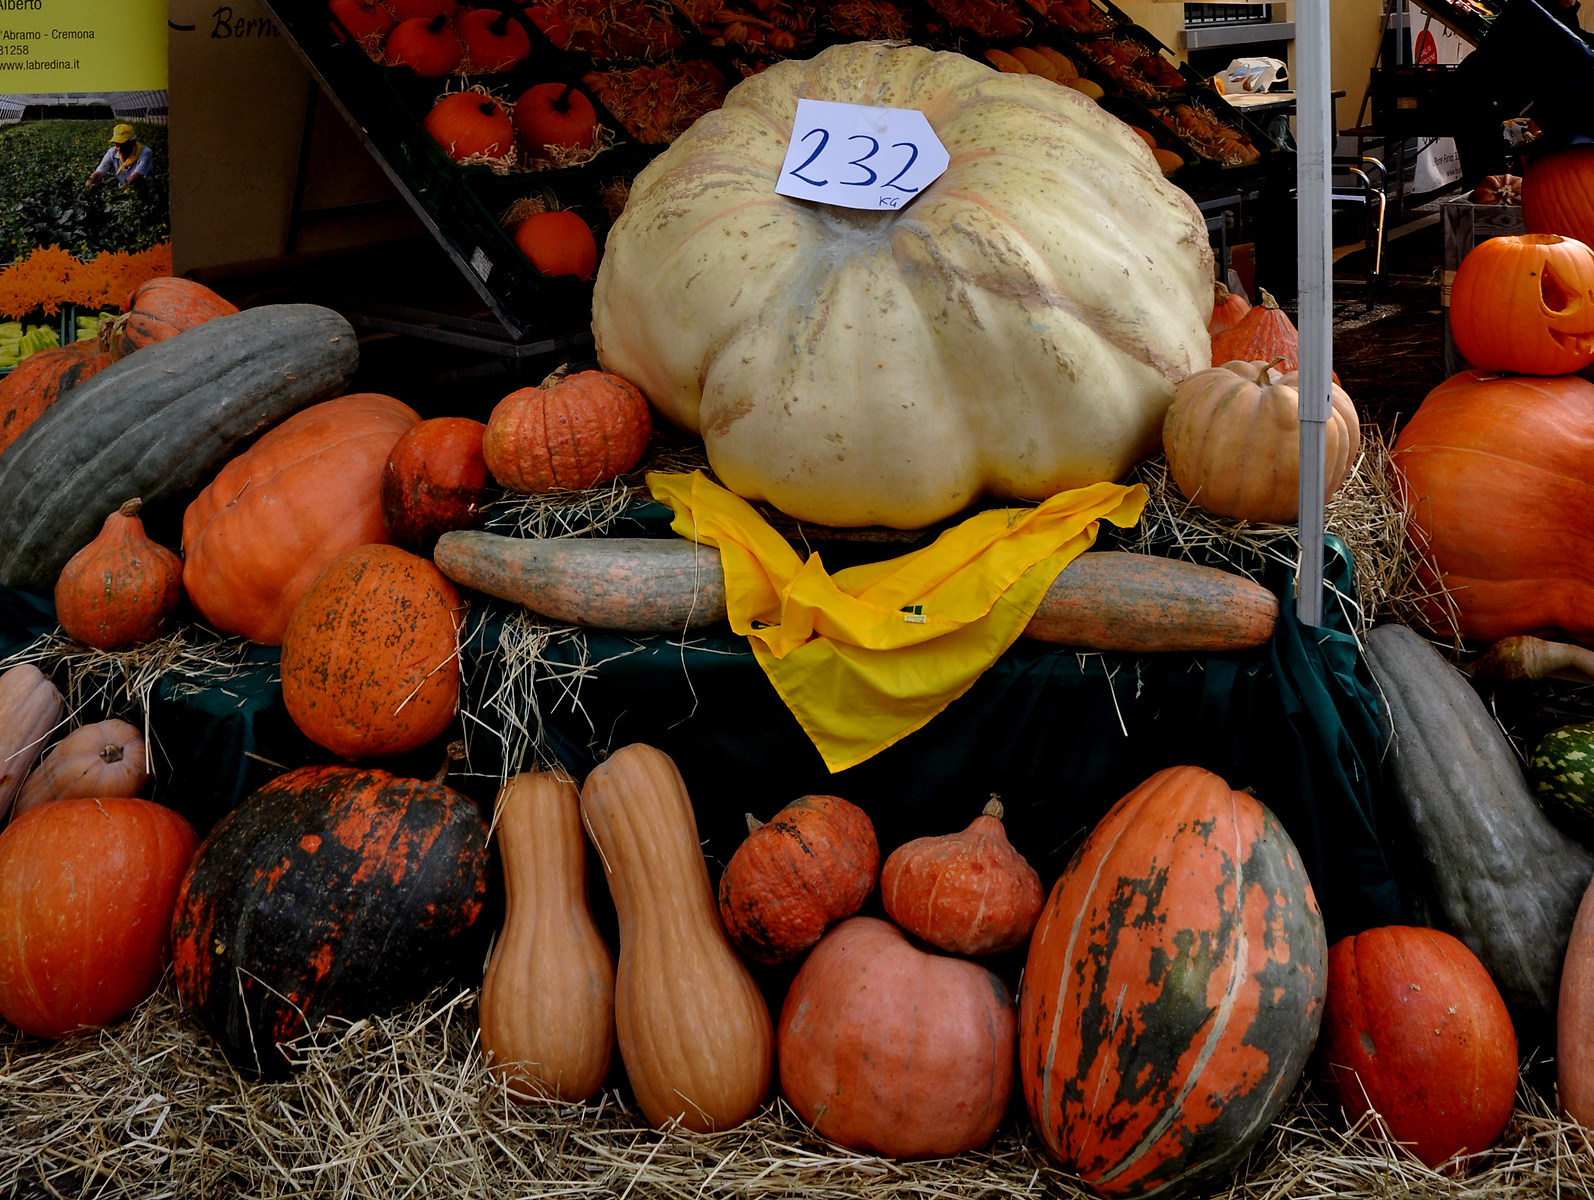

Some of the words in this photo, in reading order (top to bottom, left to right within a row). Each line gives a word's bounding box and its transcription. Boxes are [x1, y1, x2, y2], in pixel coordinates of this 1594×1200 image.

[51, 29, 95, 40] Cremona
[0, 59, 80, 71] www.labredina.it
[789, 128, 919, 193] 232
[878, 196, 900, 207] KG
